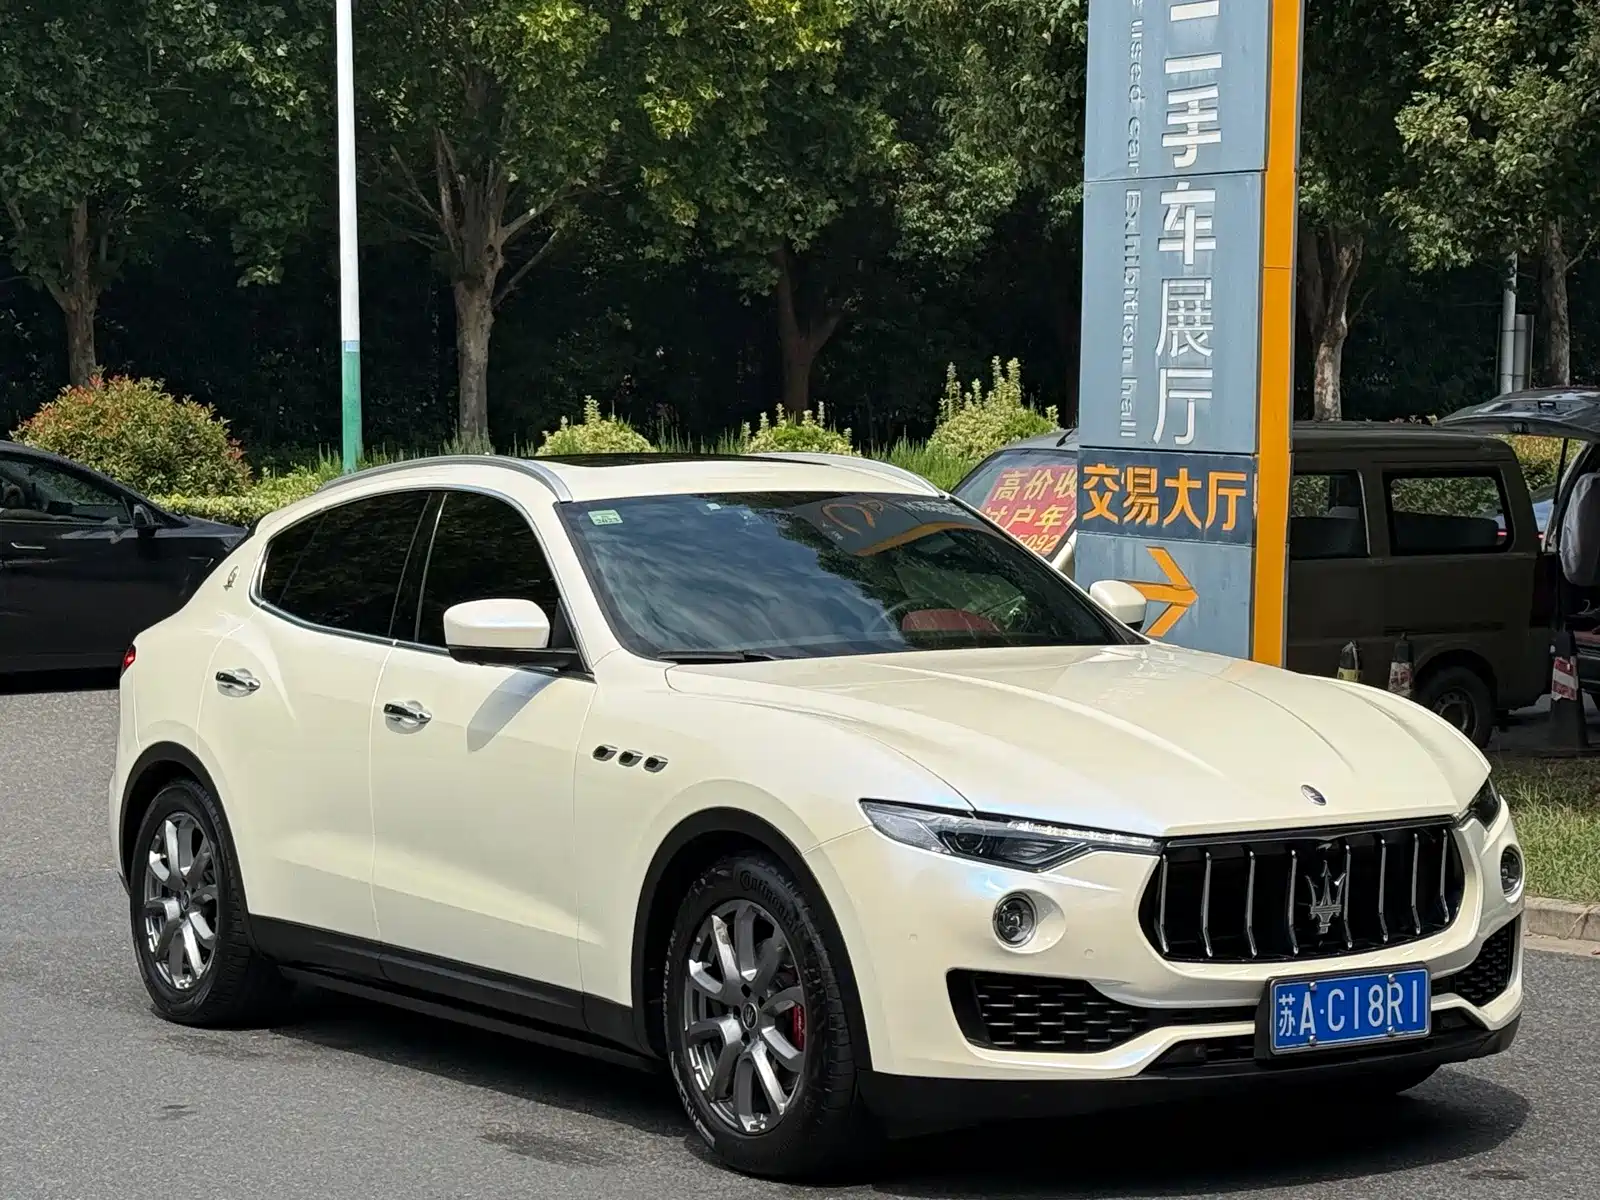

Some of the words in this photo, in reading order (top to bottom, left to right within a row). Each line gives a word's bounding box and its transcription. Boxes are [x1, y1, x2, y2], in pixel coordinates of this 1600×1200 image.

[1128, 19, 1145, 101] used
[1127, 116, 1141, 174] car
[1153, 1, 1223, 445] 二手车展厅
[1122, 189, 1141, 364] Exhibition
[1120, 376, 1137, 437] hall
[1082, 463, 1248, 532] 交易大厅
[1278, 979, 1418, 1037] 苏A·C18R1
